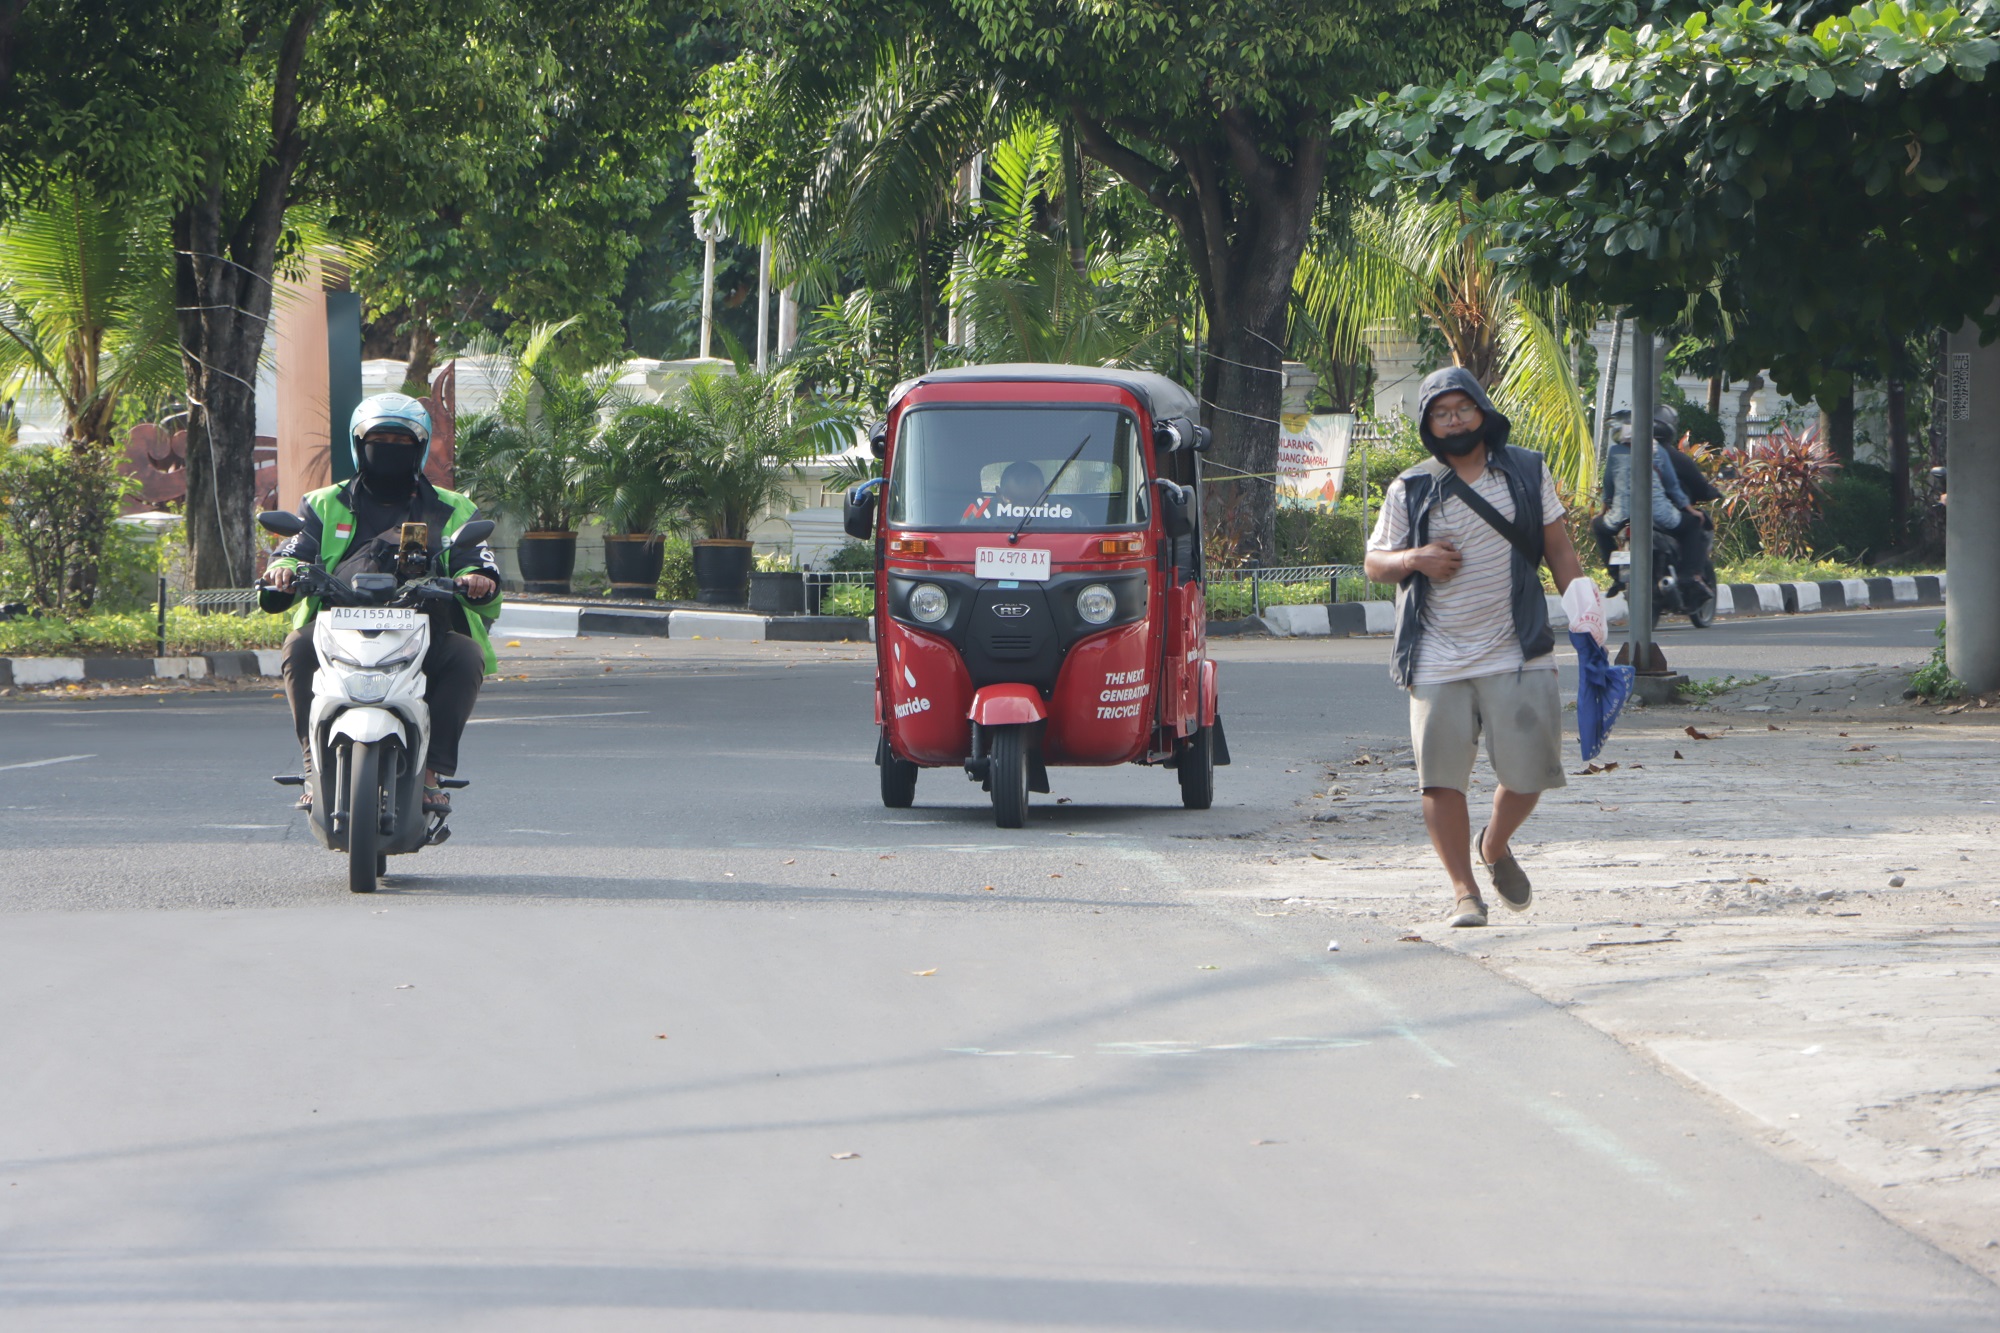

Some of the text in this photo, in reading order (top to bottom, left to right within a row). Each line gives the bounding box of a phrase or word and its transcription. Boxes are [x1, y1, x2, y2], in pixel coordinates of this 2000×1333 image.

[1953, 360, 1968, 369] WC
[1301, 454, 1328, 466] SAMPAH
[997, 502, 1072, 519] Maxride
[980, 551, 1045, 565] AD 4578 AX
[1000, 607, 1022, 615] RE
[1105, 668, 1145, 685] THE NEXT
[1099, 683, 1150, 702] GENERATION
[1097, 703, 1141, 719] TRICYCLE
